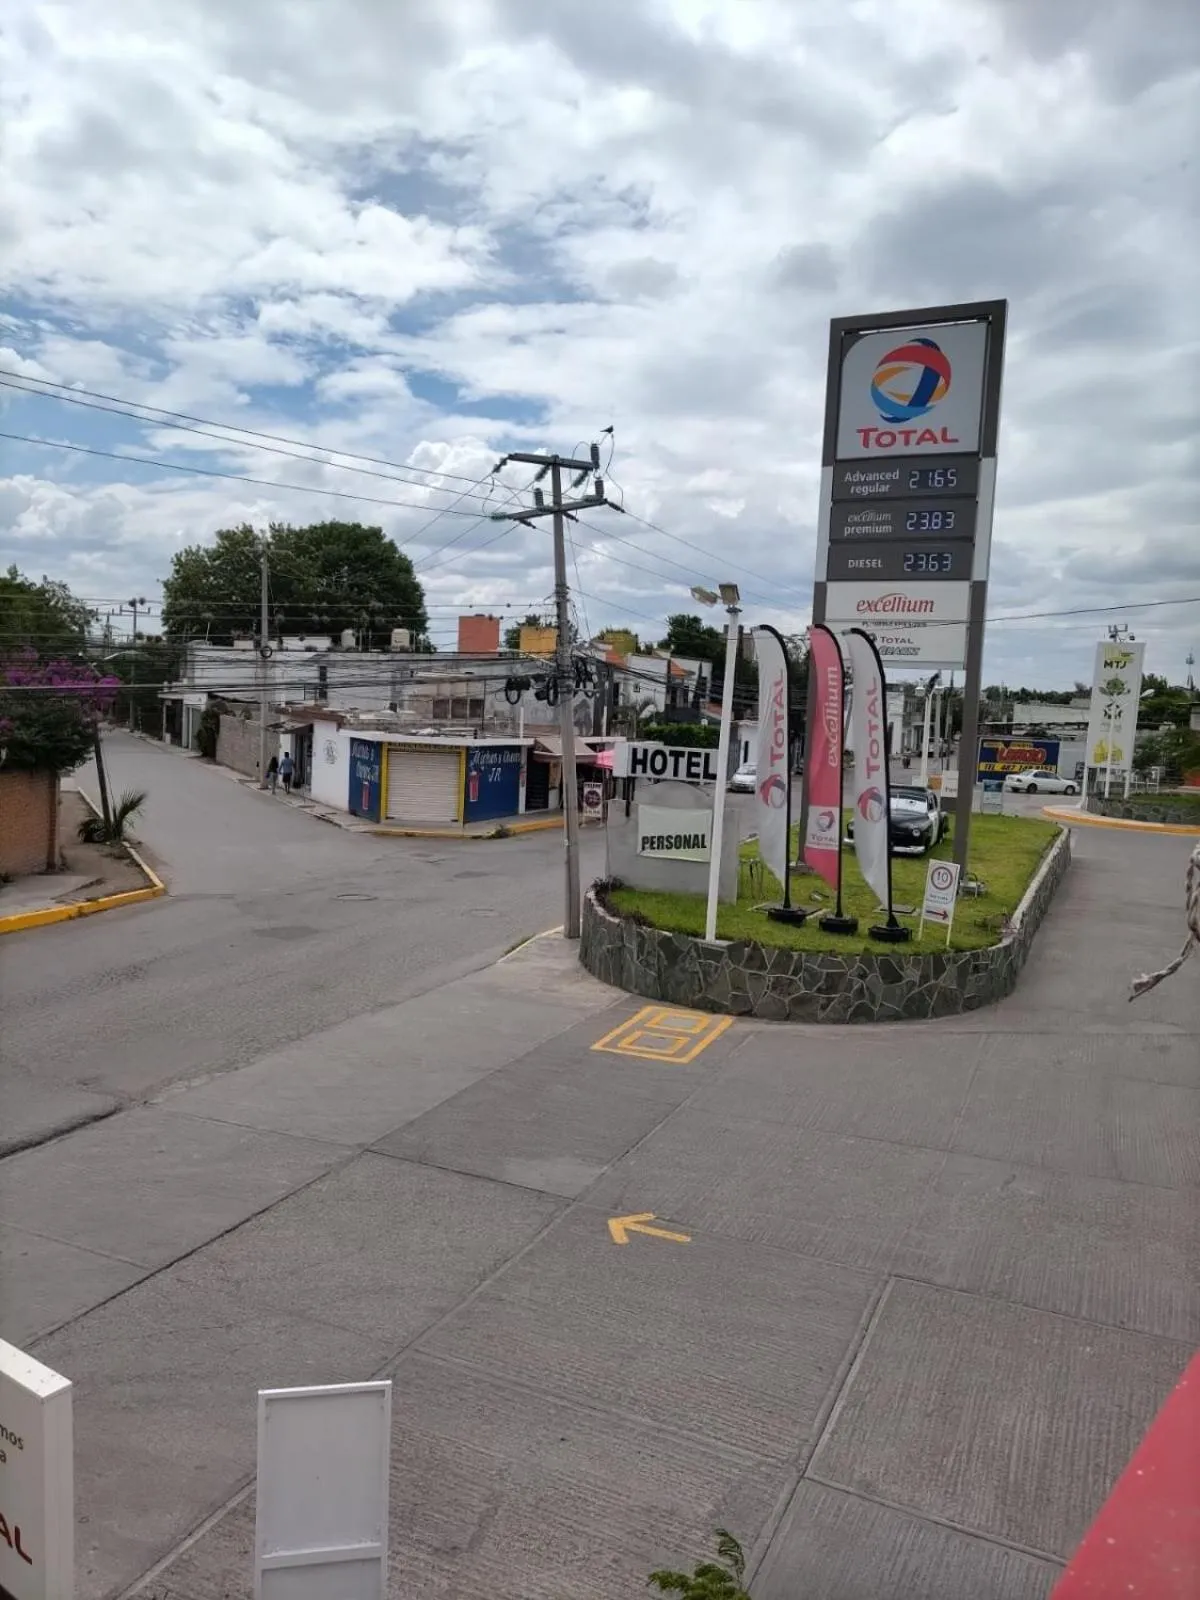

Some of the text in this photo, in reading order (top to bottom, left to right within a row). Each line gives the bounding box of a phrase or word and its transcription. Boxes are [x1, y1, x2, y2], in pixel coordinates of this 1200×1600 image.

[856, 427, 959, 449] TOTAL
[844, 468, 900, 482] Advanced
[850, 483, 890, 496] regular
[847, 509, 892, 523] excellium
[844, 524, 892, 537] premium
[848, 559, 883, 569] DIESEL
[856, 593, 935, 613] excellium
[879, 636, 914, 644] TOTAL
[1103, 660, 1127, 669] MTJ
[770, 669, 785, 768] TOTAL
[822, 666, 839, 769] excellium
[865, 676, 881, 780] TOTAL
[630, 748, 718, 780] HOTEL
[641, 834, 707, 852] PERSONAL
[937, 871, 949, 883] 10
